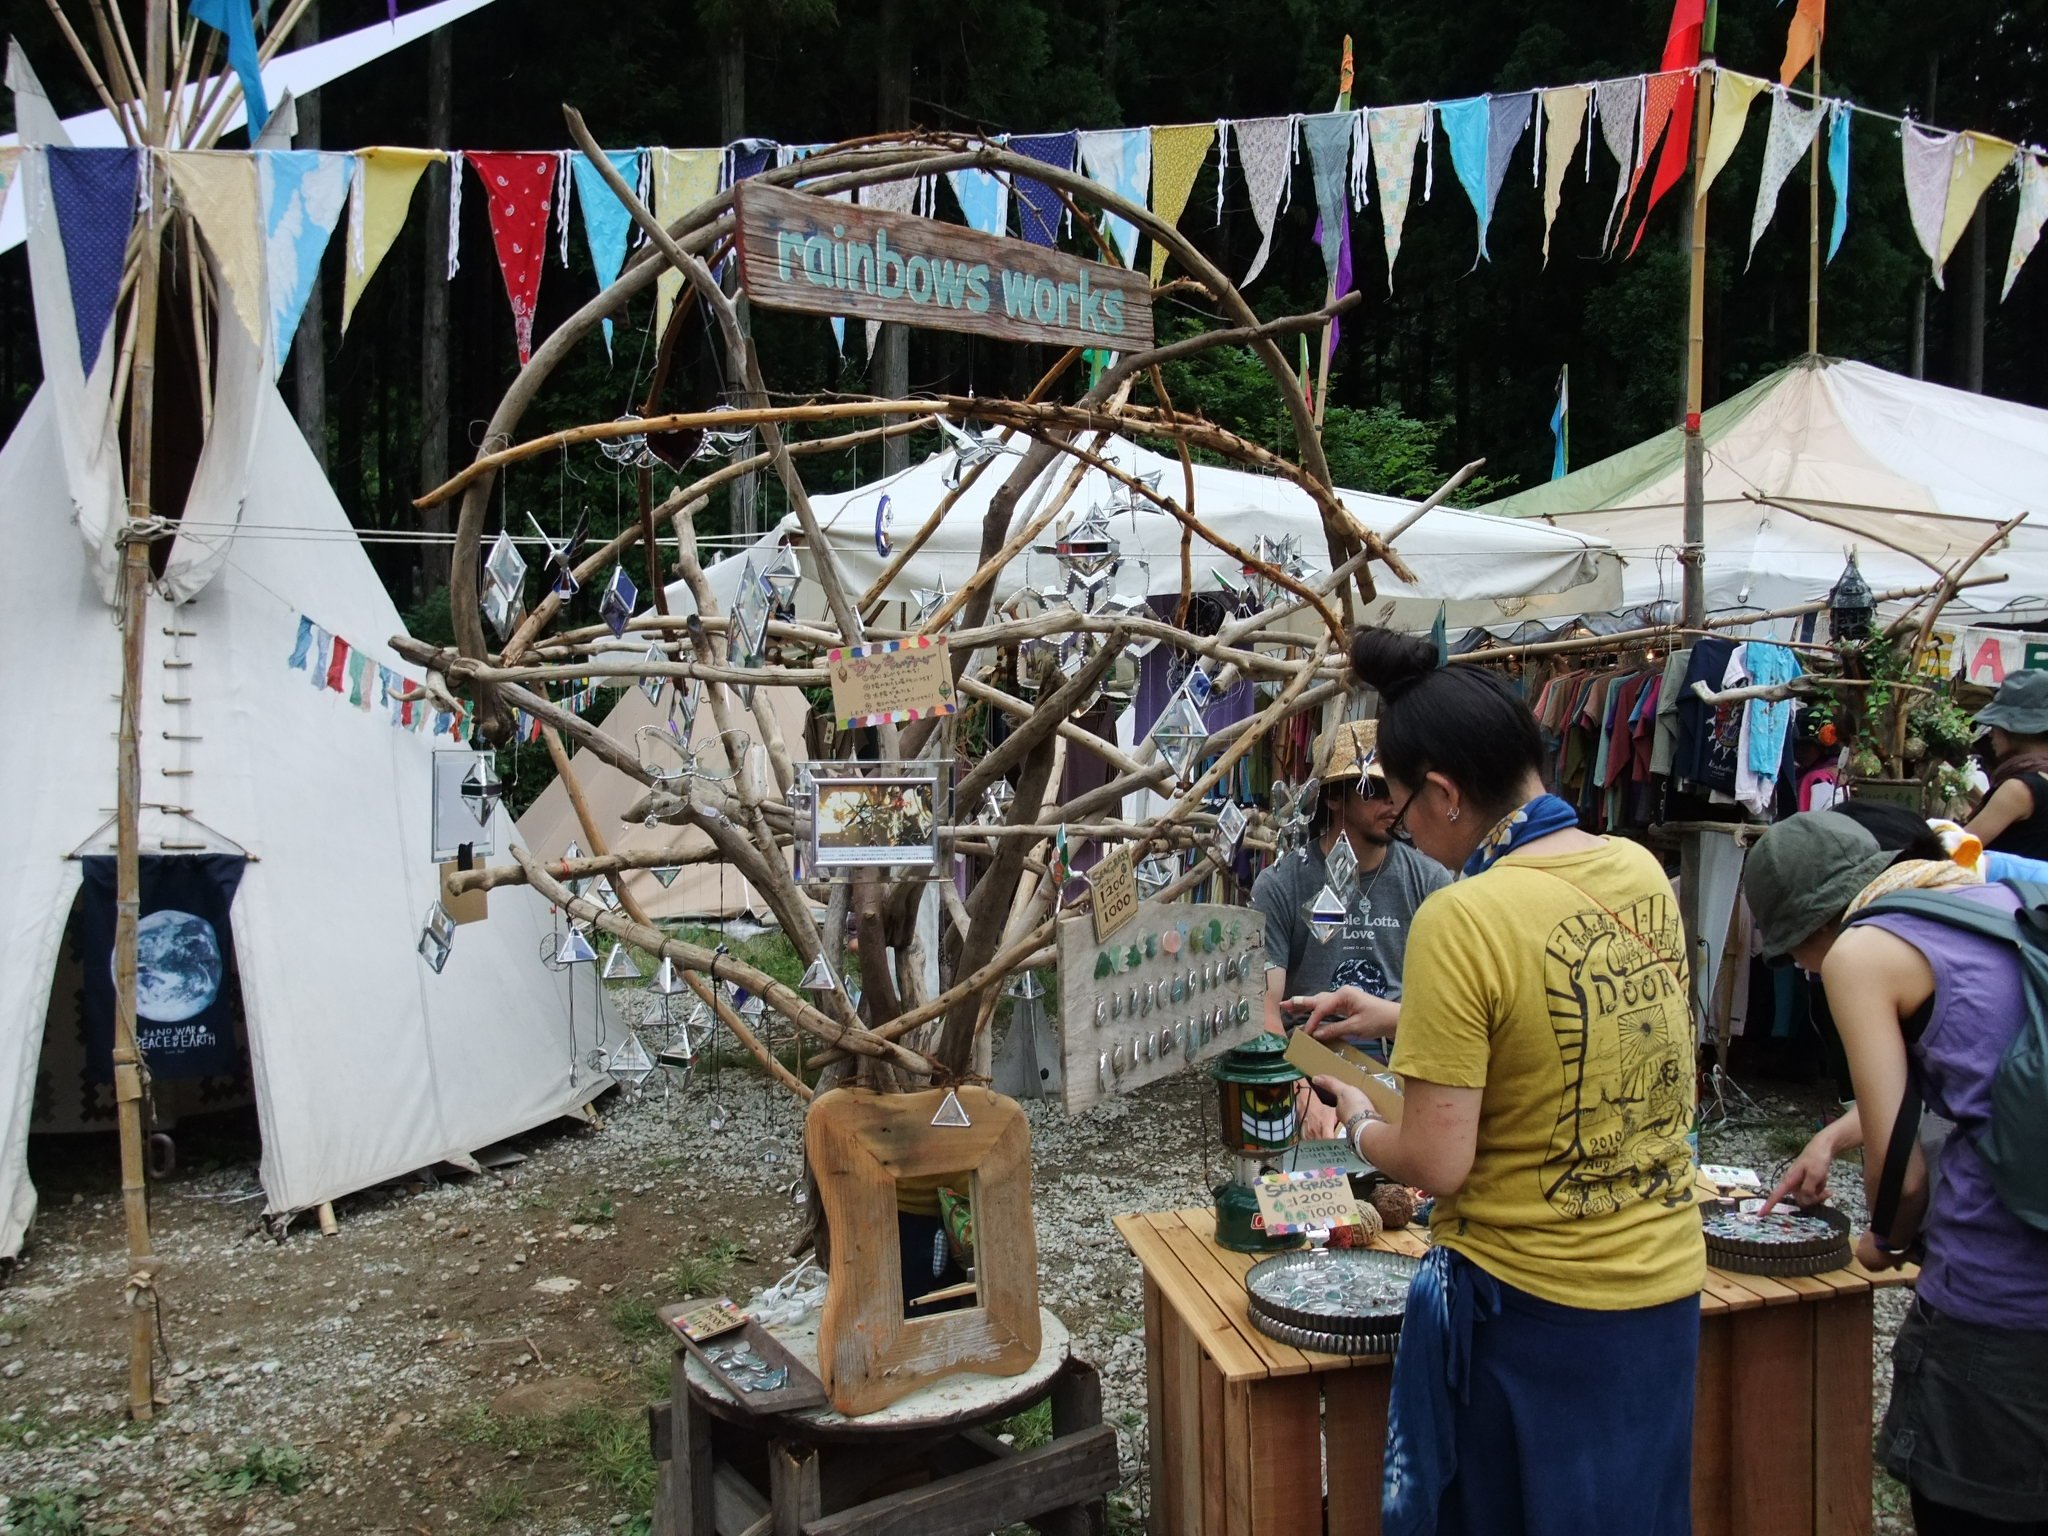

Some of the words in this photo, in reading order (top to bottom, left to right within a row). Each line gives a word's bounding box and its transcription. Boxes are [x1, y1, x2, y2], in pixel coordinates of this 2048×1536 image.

[777, 225, 990, 312] rainbows
[1002, 268, 1126, 335] works
[1104, 893, 1131, 922] 1000
[1364, 914, 1401, 928] Lotta
[1342, 927, 1375, 940] Love
[1591, 968, 1675, 1014] DOOR
[174, 1025, 196, 1036] WAR
[136, 1035, 171, 1050] PEACE
[181, 1032, 216, 1048] EARTH
[1590, 1131, 1622, 1155] 2010
[1292, 1192, 1333, 1206] 1200
[1310, 1204, 1347, 1218] 1000
